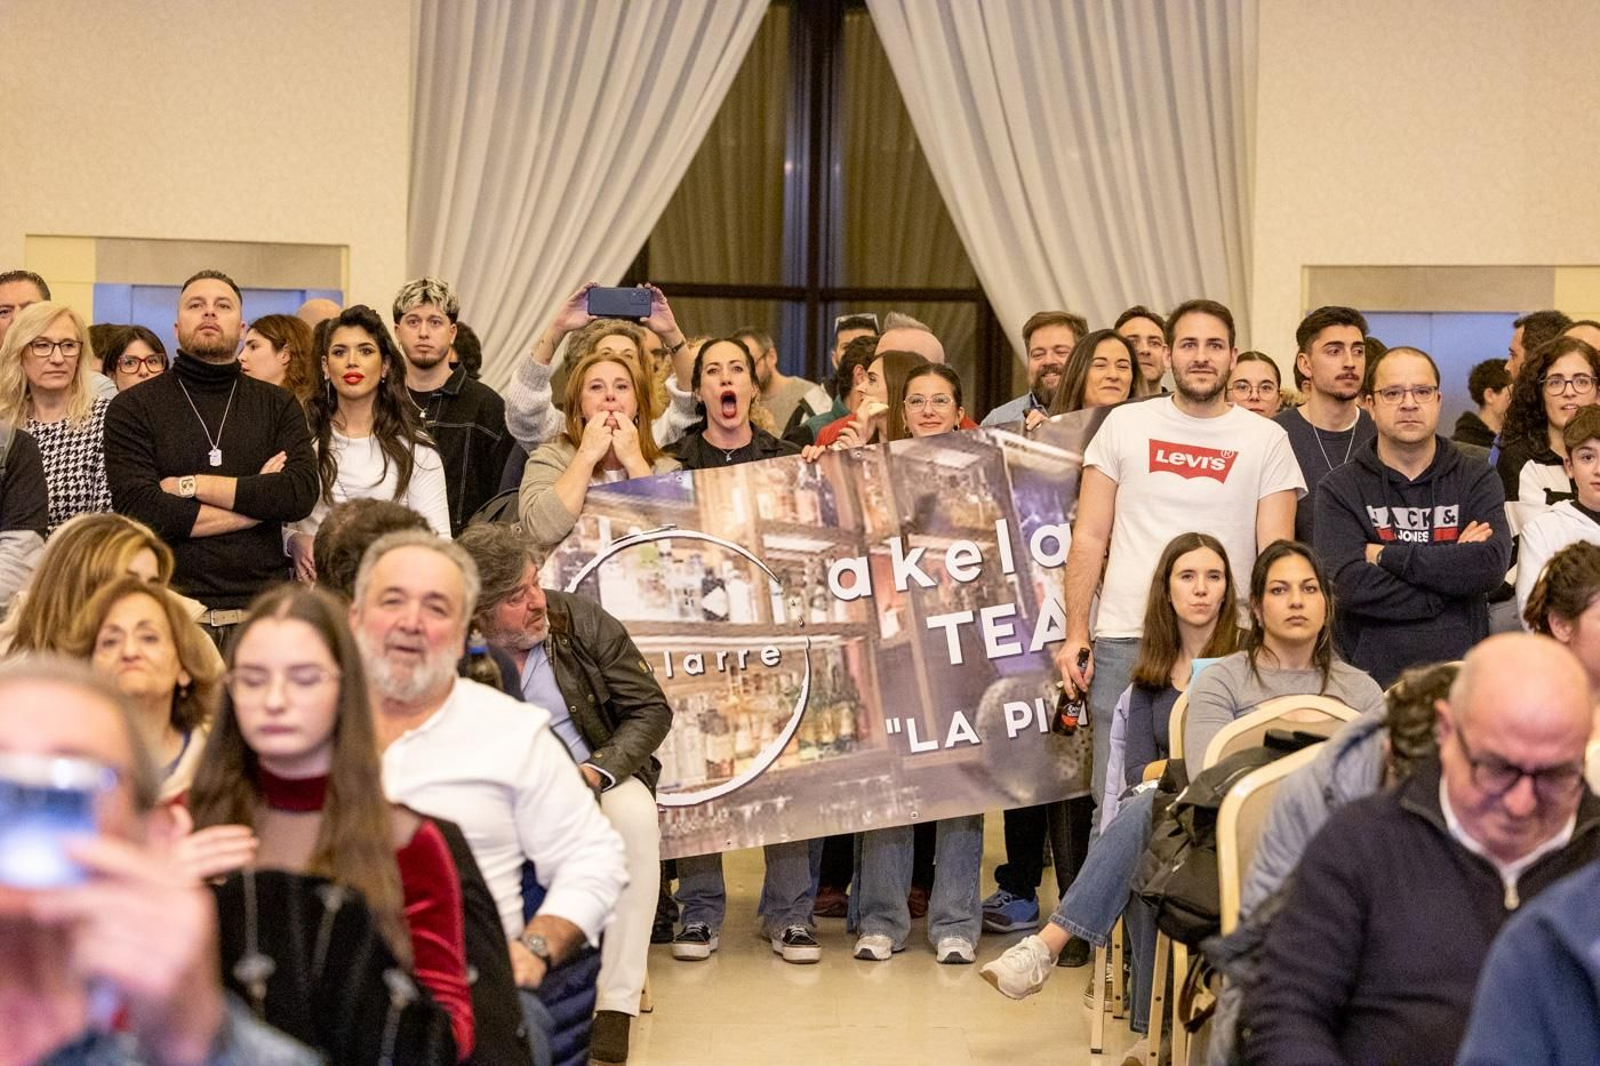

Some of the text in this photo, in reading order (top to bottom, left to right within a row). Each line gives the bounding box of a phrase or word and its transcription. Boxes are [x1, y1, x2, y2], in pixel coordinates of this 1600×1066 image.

[1398, 529, 1429, 543] JONES
[926, 592, 1098, 665] TEA
[647, 645, 781, 678] larre
